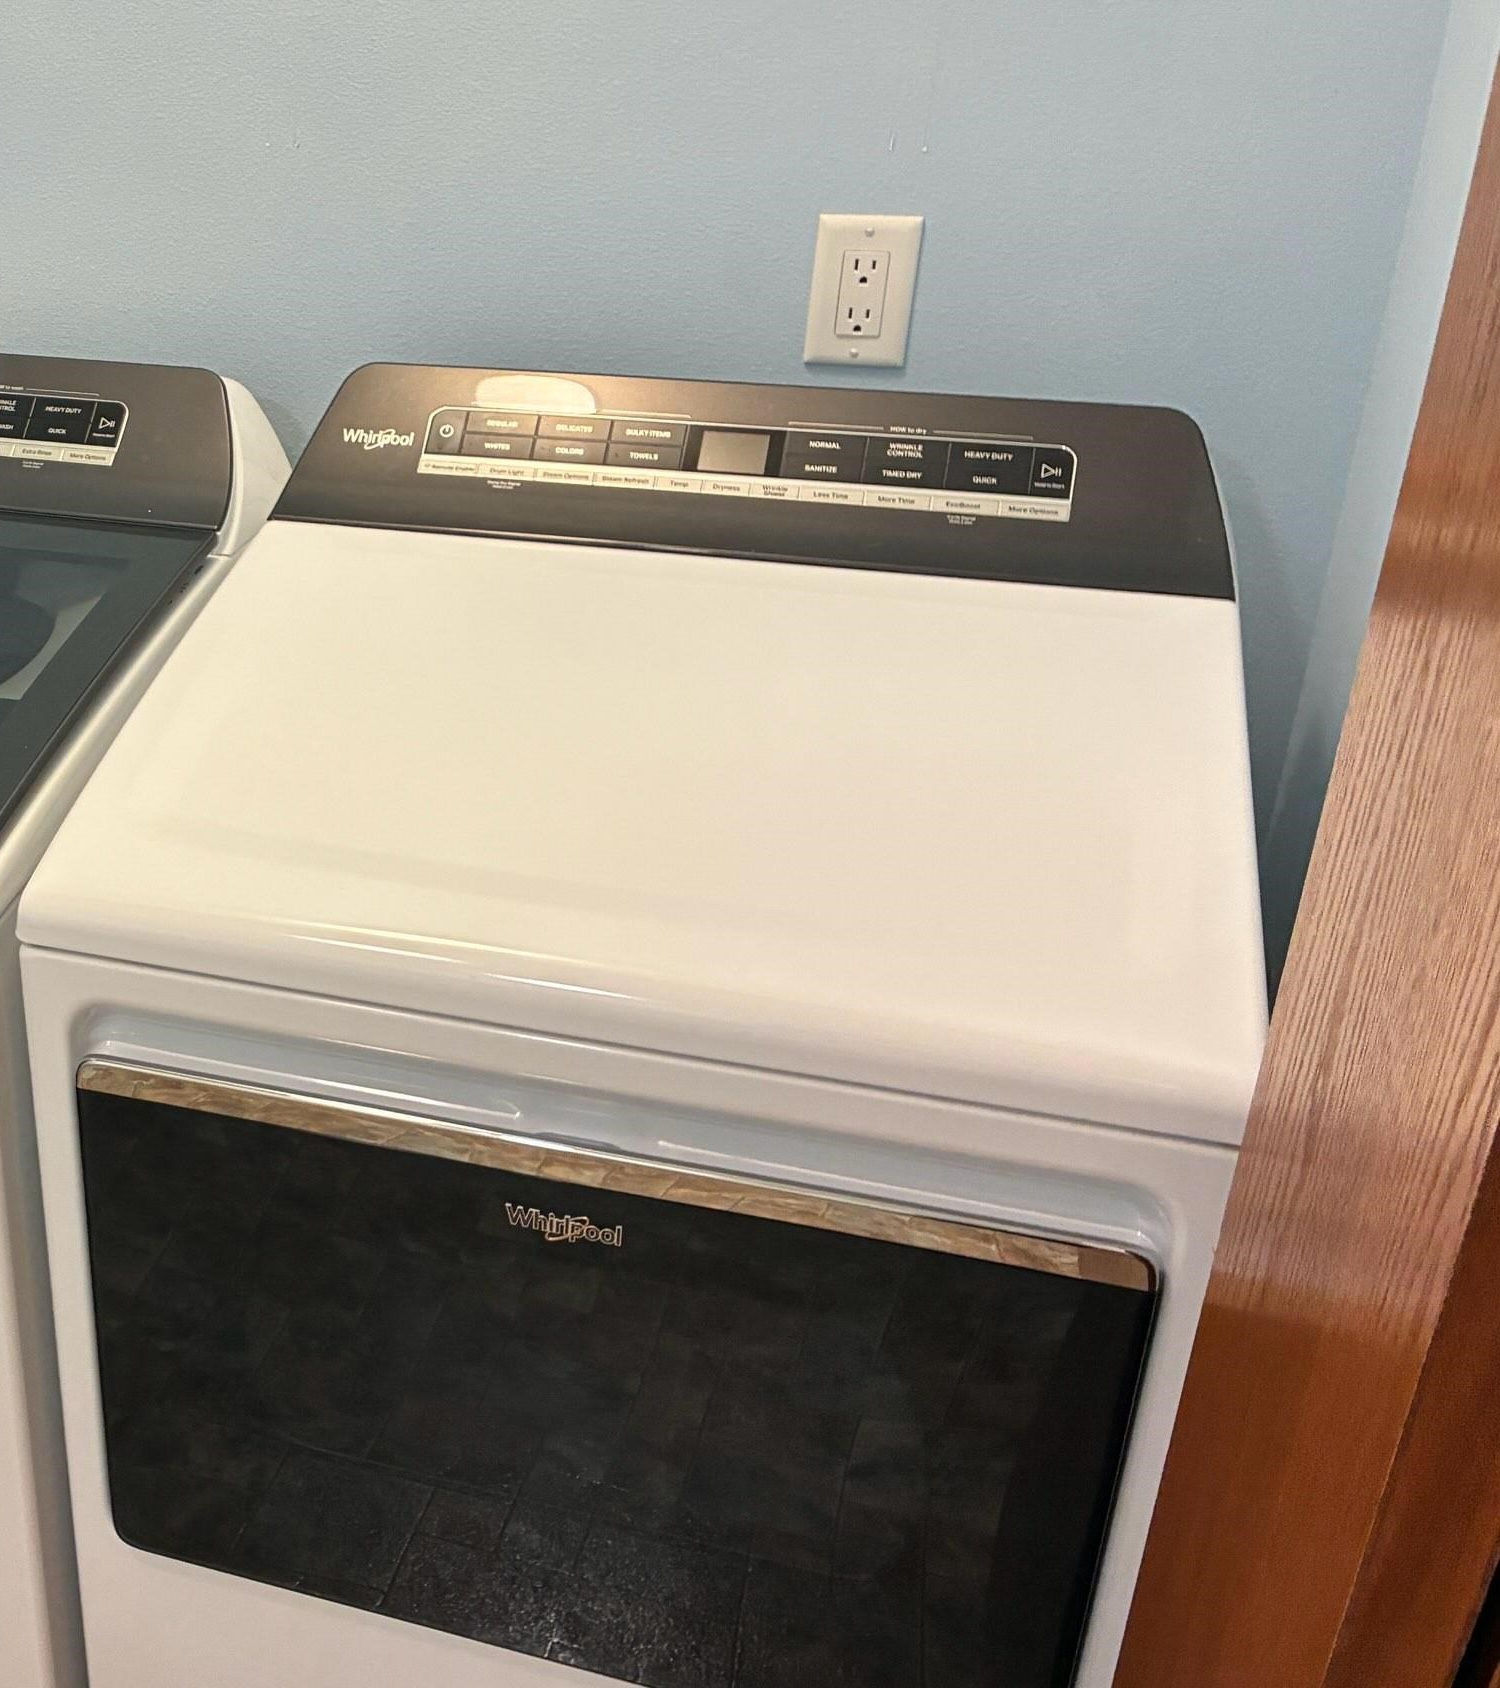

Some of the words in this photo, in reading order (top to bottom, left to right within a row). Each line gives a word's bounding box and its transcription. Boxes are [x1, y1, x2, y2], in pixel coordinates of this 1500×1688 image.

[556, 424, 593, 432] DELICATES
[626, 428, 649, 437] BULKY
[649, 430, 671, 438] ITEMS
[343, 428, 415, 450] Whirlpool
[484, 442, 510, 450] WHITES
[809, 440, 841, 450] NORMAL
[889, 442, 923, 451] WRINKLE
[555, 447, 584, 455] COLORS
[629, 451, 658, 460] TOWELS
[886, 449, 923, 458] CONTROL
[964, 450, 990, 460] HEAVY
[991, 452, 1013, 461] DUTY
[508, 468, 524, 476] Light
[804, 464, 838, 473] SANITIZE
[882, 469, 905, 478] TIMED
[906, 471, 923, 480] DRY
[972, 475, 997, 485] QUICK
[713, 483, 740, 492] Dryness
[762, 484, 788, 492] Wrinkle
[878, 495, 896, 503] More
[1009, 505, 1028, 513] More
[1029, 507, 1059, 515] Options
[505, 1202, 623, 1247] Whirlpool
